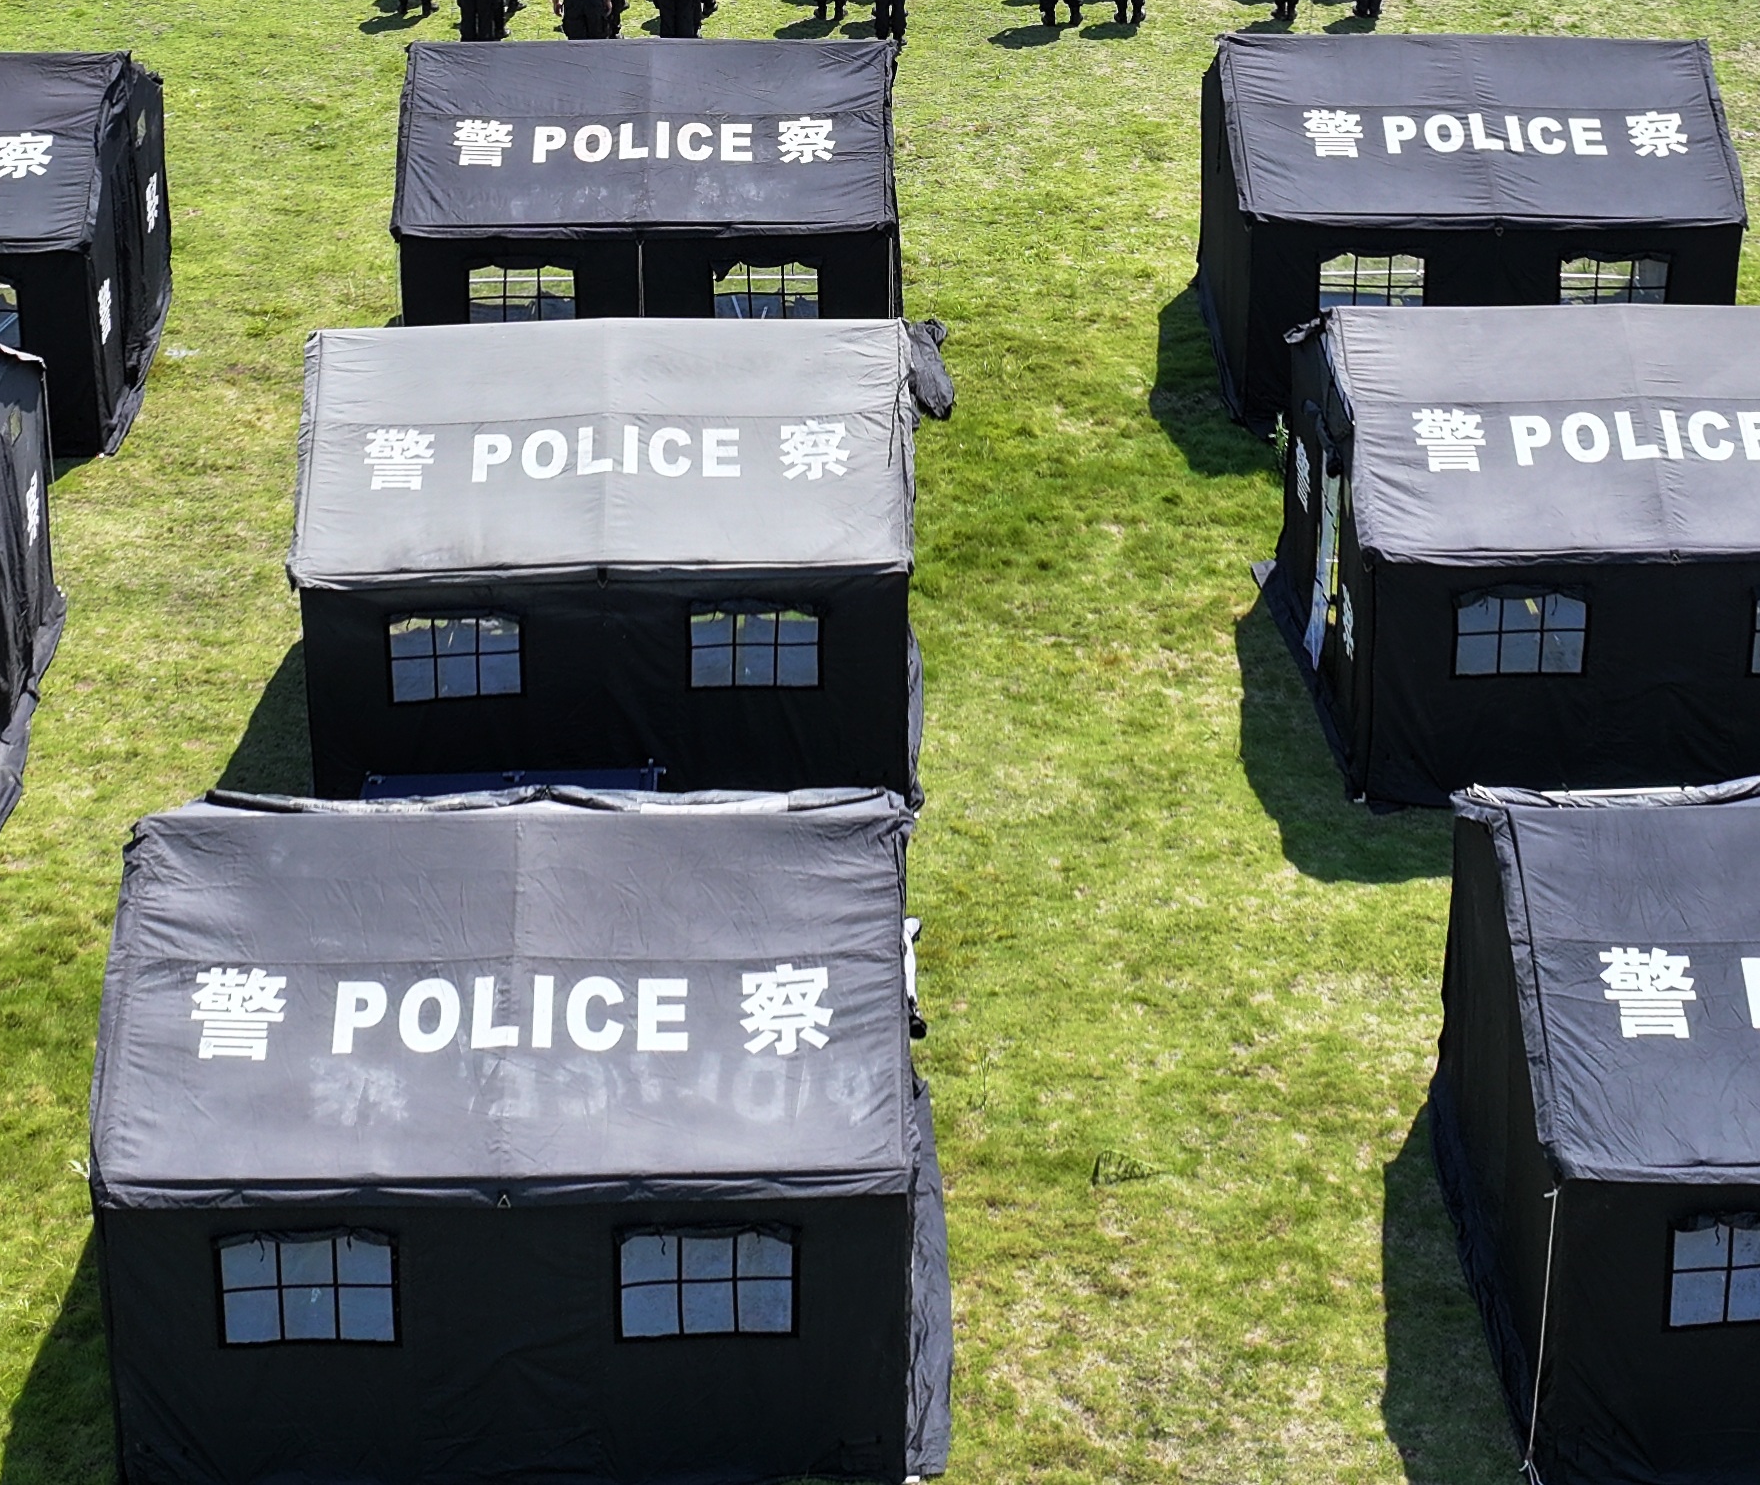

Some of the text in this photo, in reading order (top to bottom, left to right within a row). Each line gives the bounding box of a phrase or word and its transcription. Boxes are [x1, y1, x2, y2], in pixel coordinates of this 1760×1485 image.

[453, 117, 835, 166] 警 POLICE 察
[1303, 110, 1688, 157] 警 POLICE 察
[364, 420, 850, 490] 警 POLICE 察
[1412, 409, 1486, 472] 警
[191, 964, 833, 1060] 警 POLICE 察
[1599, 947, 1696, 1038] 警
